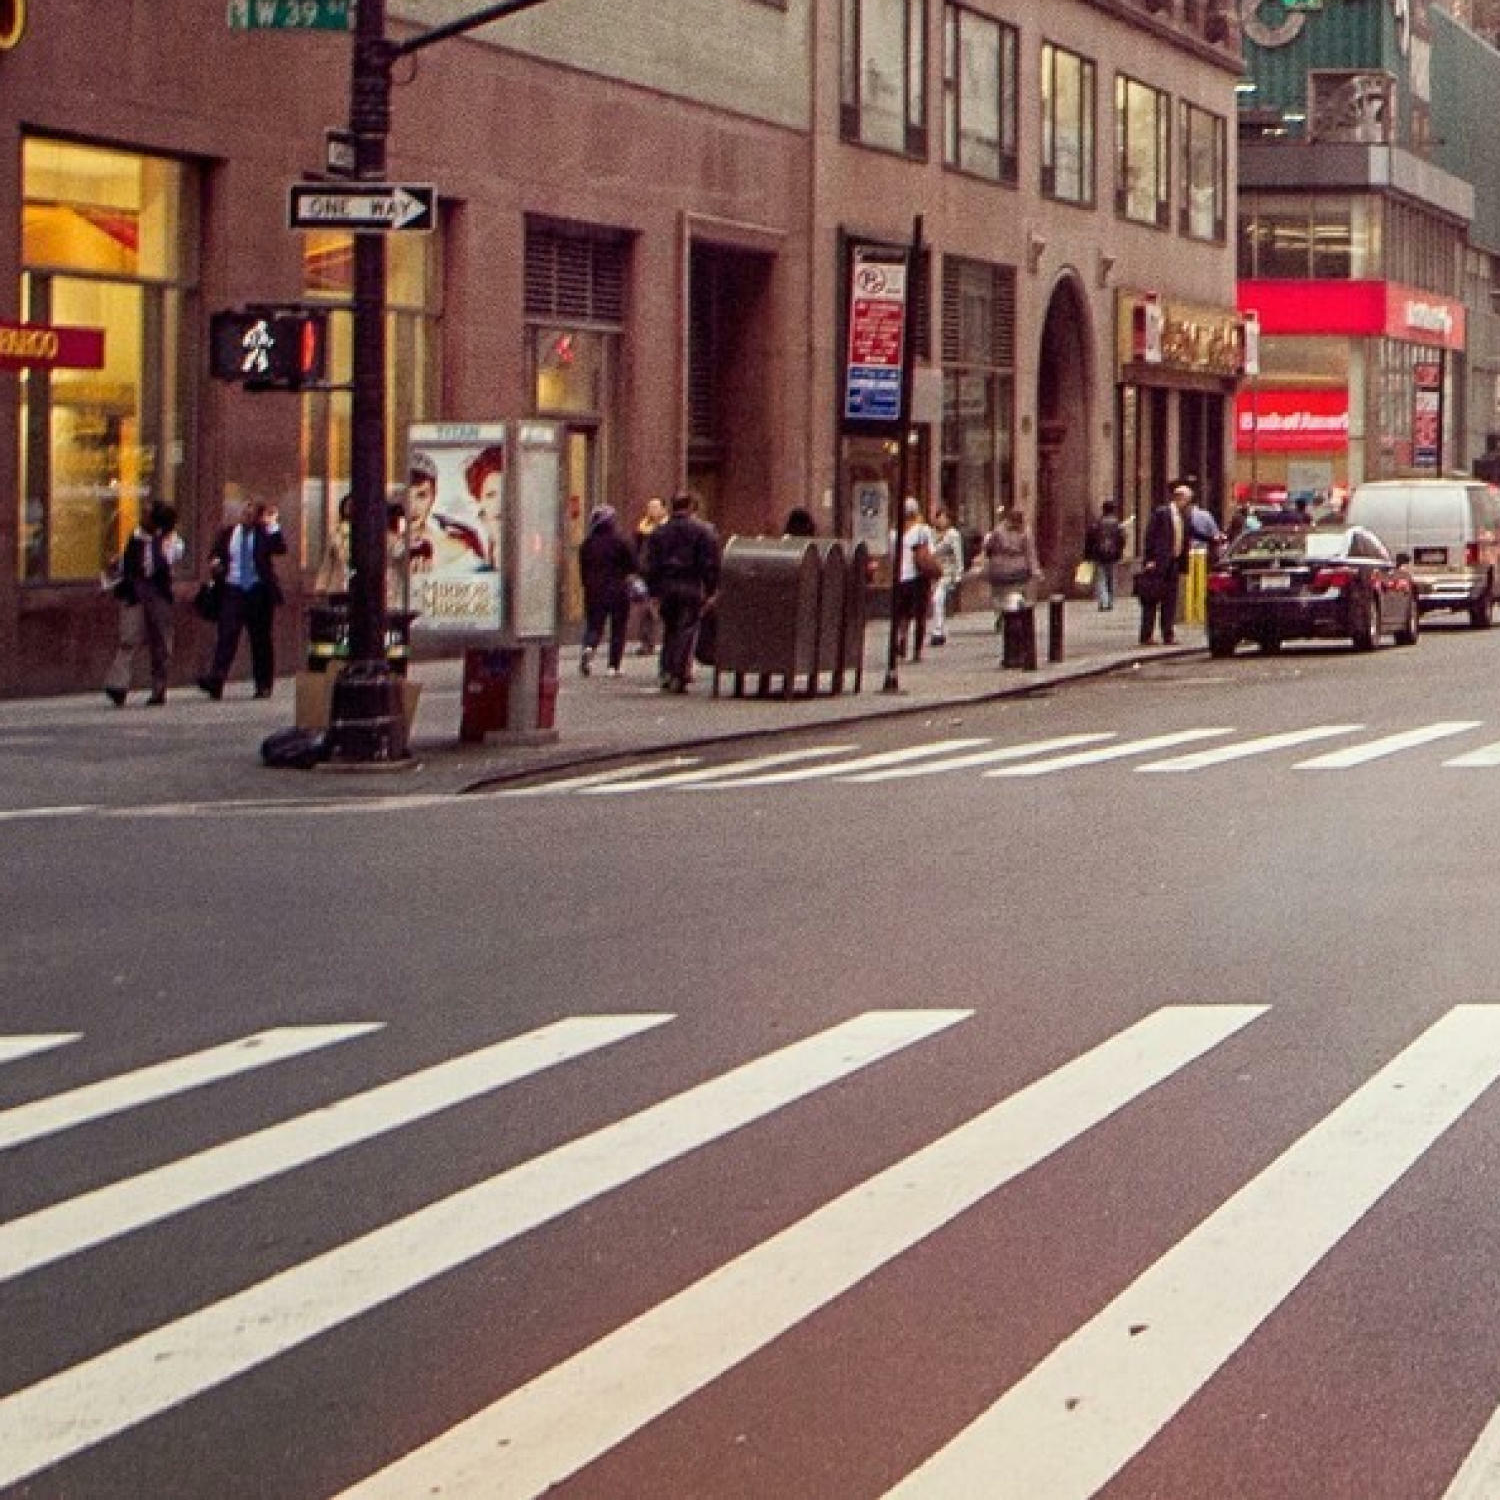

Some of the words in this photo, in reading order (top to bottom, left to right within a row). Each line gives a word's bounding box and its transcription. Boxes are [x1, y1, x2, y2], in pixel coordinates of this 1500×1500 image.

[254, 0, 277, 27] W
[310, 197, 346, 218] ONE
[370, 197, 412, 218] WAY
[1302, 411, 1348, 430] Ameri
